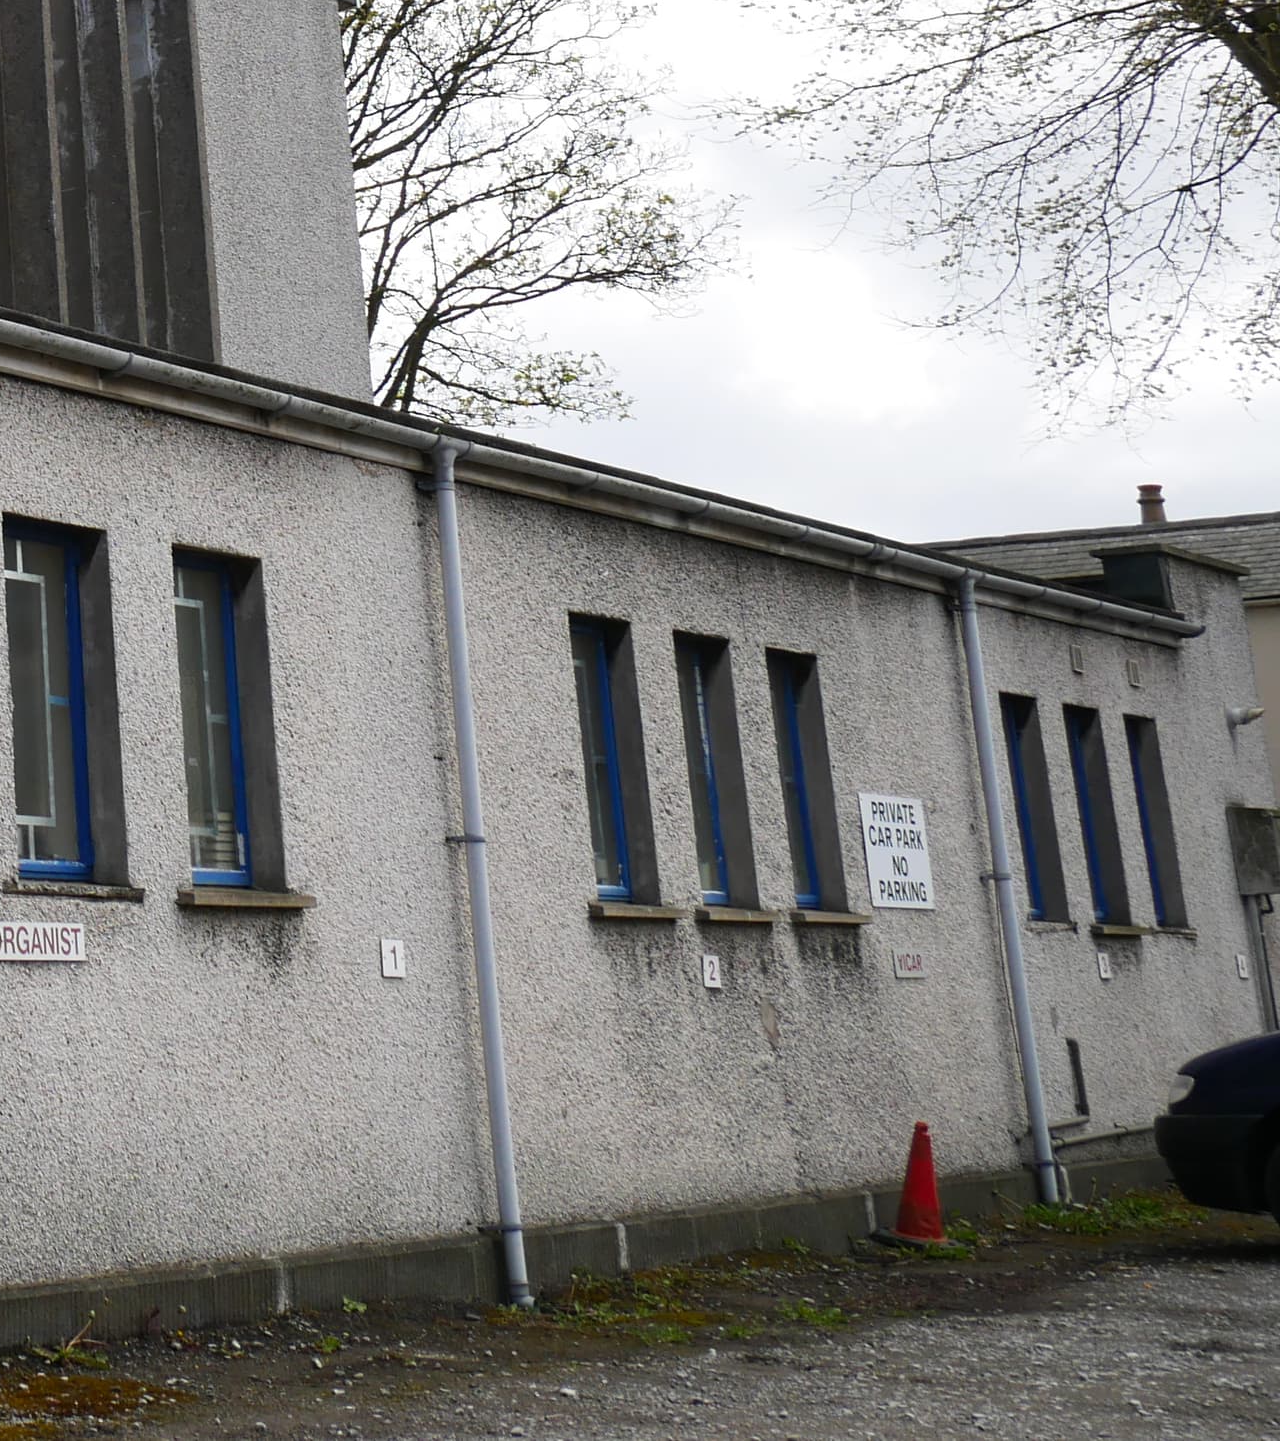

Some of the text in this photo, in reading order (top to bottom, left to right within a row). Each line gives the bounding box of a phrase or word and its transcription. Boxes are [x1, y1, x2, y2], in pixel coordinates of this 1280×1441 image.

[871, 801, 916, 825] PRIVATE
[868, 825, 924, 850] CAR PARK
[892, 855, 909, 877] NO
[879, 880, 928, 902] PARKING
[390, 945, 398, 970] 1
[897, 953, 923, 972] VICAR
[708, 960, 717, 981] 2
